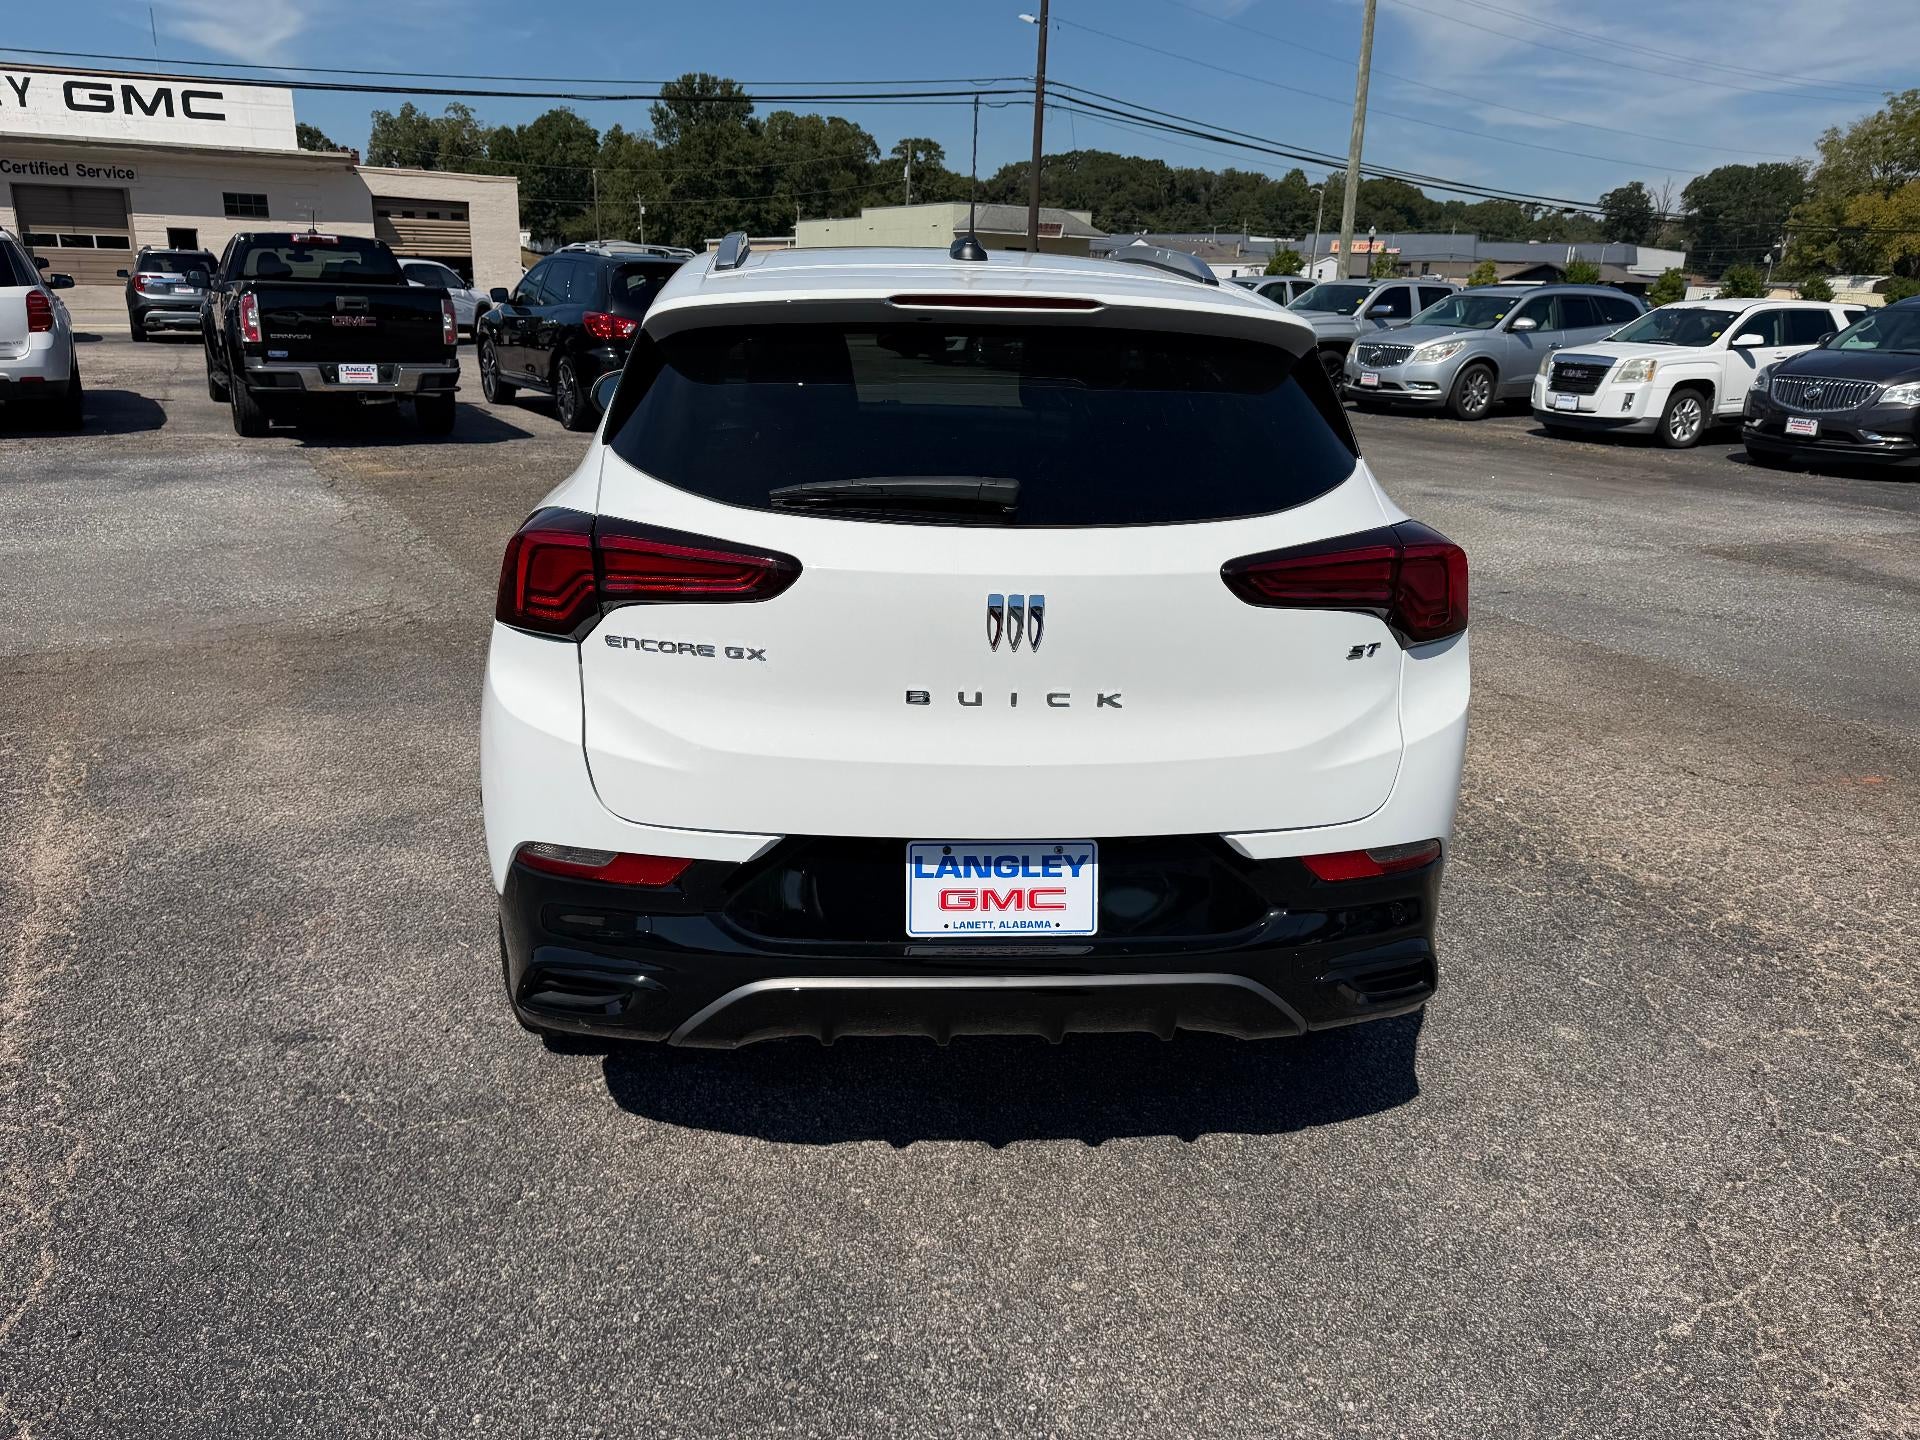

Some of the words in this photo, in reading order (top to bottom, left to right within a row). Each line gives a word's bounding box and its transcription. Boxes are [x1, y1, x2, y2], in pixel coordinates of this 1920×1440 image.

[0, 76, 31, 108] Y
[63, 80, 226, 121] GMC
[0, 159, 69, 177] Certified
[75, 163, 135, 180] Service
[332, 315, 377, 327] GMC
[604, 634, 716, 659] ENCORE
[724, 646, 767, 662] GX
[1346, 642, 1382, 660] ST
[906, 690, 1122, 709] BUICK
[914, 854, 1089, 879] LANGLEY
[938, 887, 1067, 912] GMC
[952, 920, 996, 930] LANETT,
[999, 920, 1051, 930] ALABAMA
